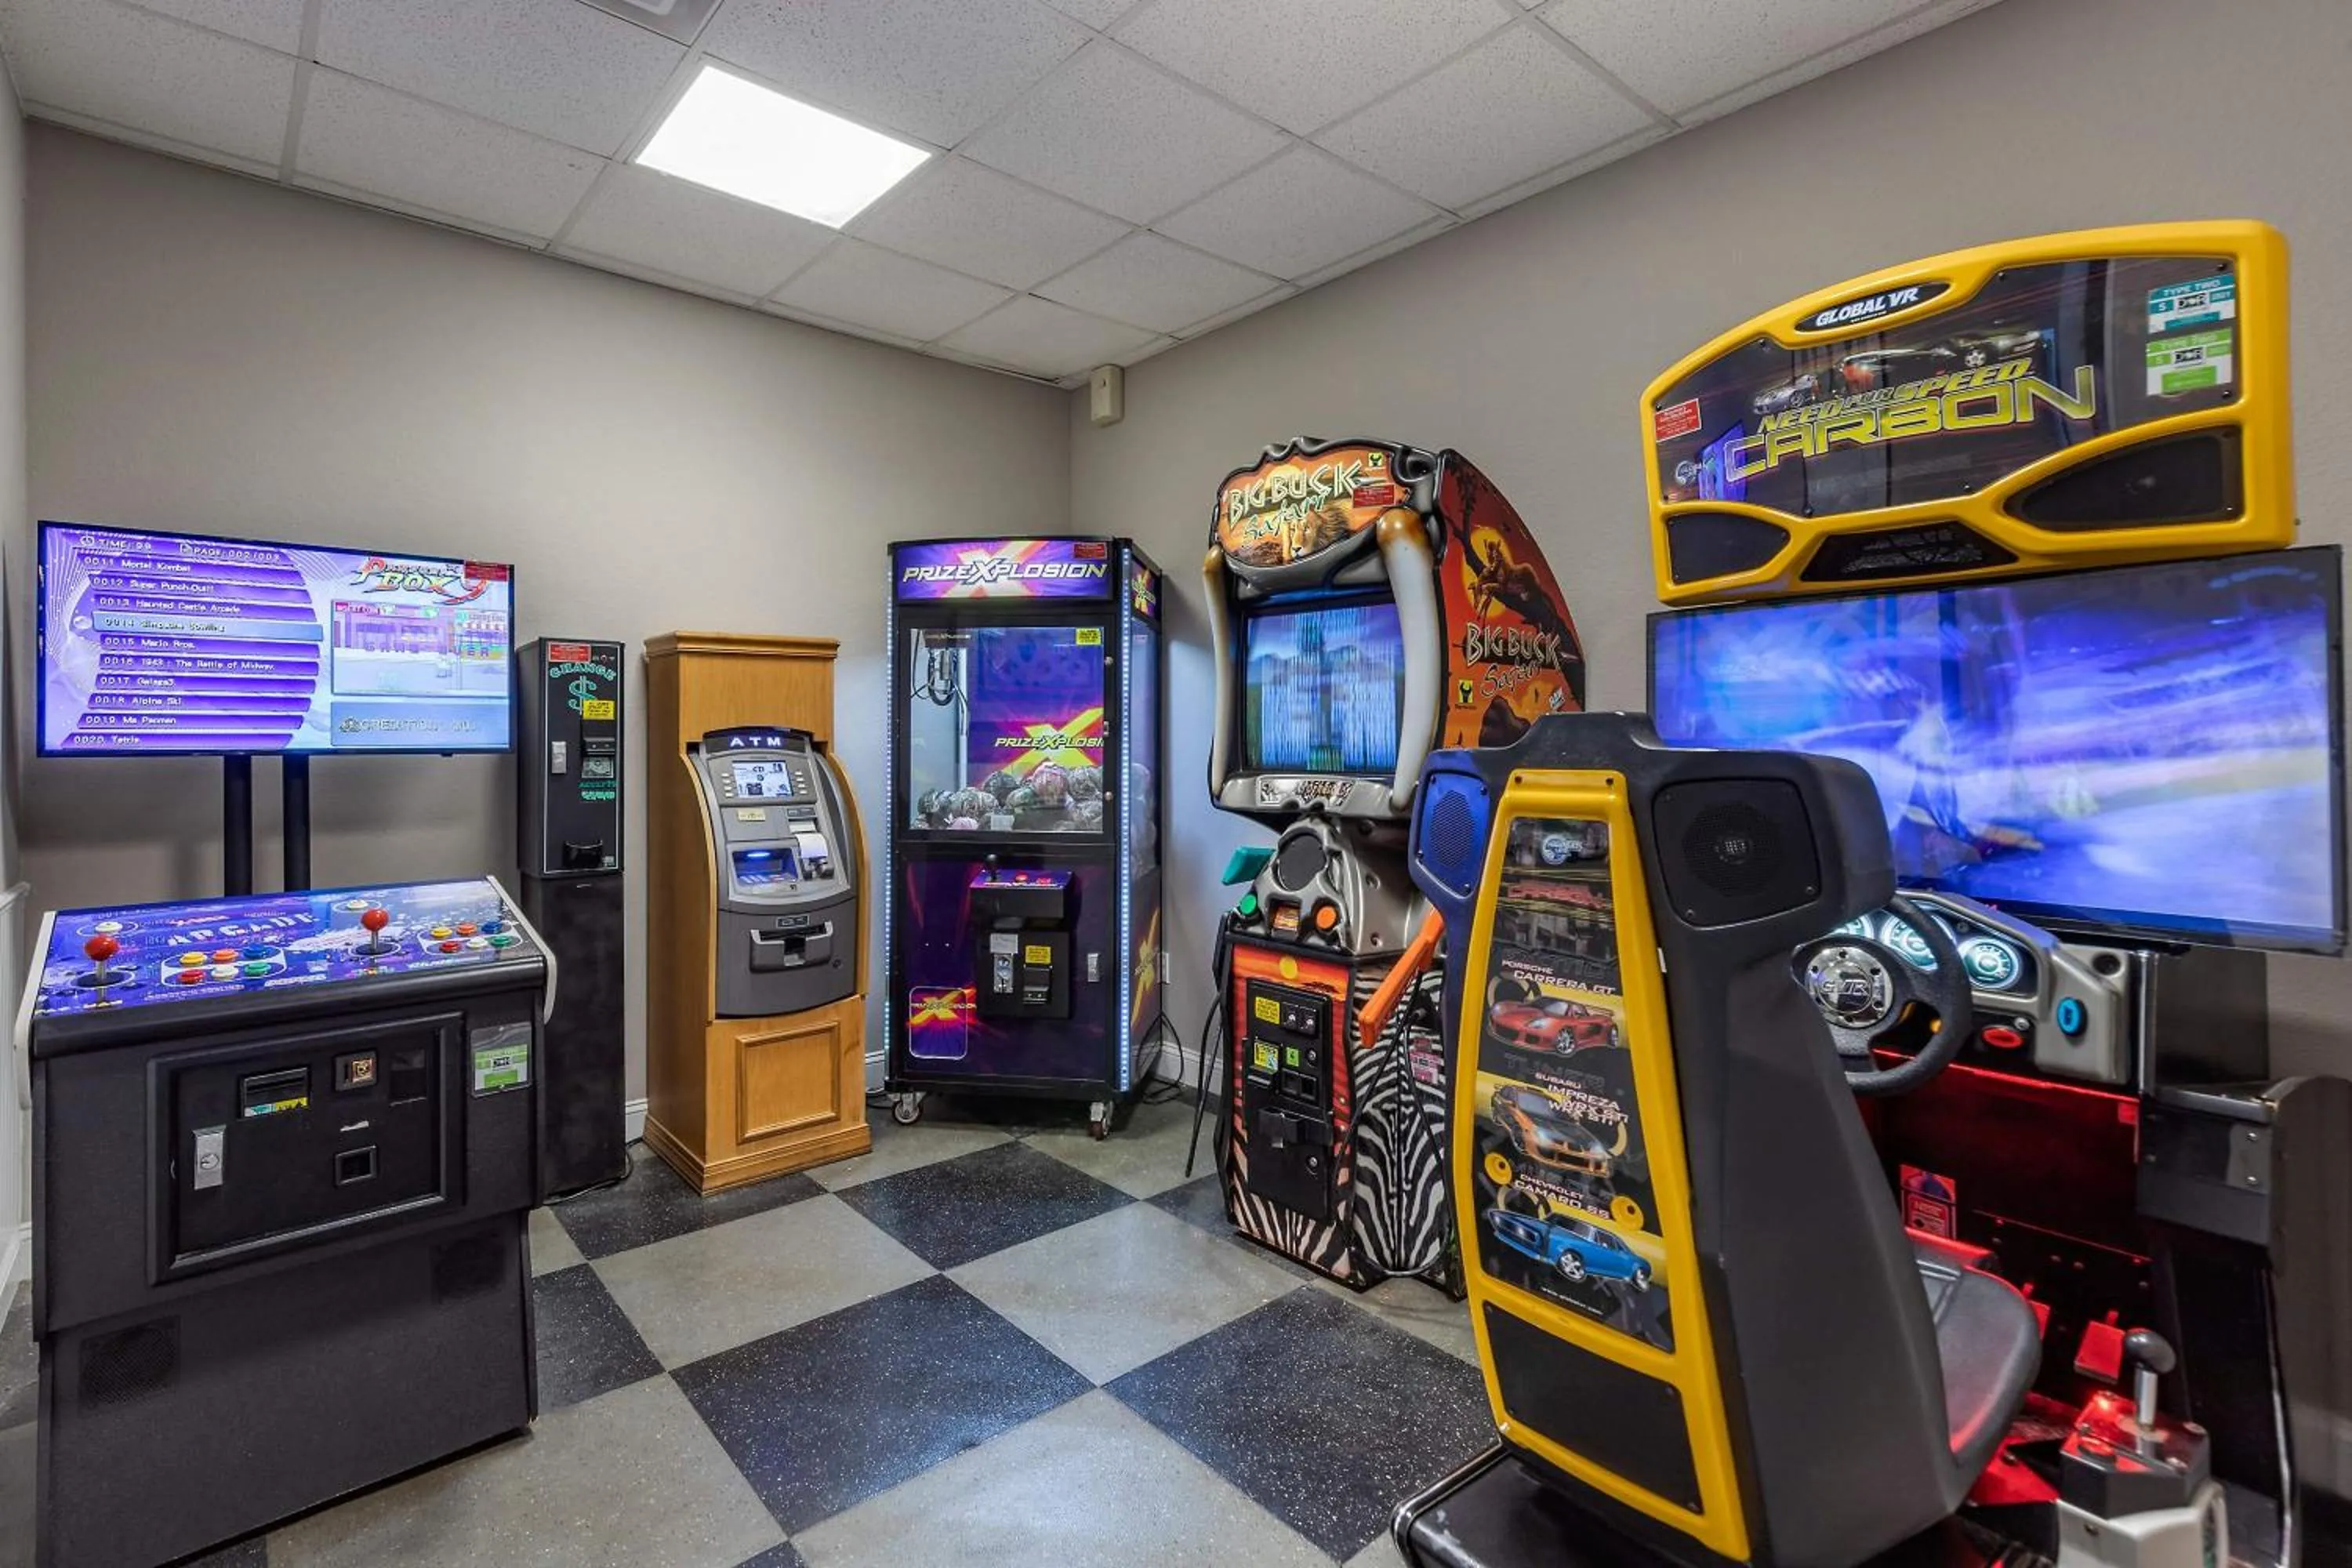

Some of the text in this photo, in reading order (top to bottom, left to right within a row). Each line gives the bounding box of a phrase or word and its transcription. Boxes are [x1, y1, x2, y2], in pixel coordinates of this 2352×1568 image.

[1815, 296, 1886, 327] GLOBAL
[1888, 287, 1919, 307] VR
[1757, 396, 1843, 434] NEED
[1893, 357, 2032, 401] SPEED
[1724, 365, 2096, 483] CARBON
[1229, 479, 1266, 530] BIG
[1269, 459, 1363, 503] BUCK
[902, 557, 1108, 586] PRIZEXPLOSION
[140, 637, 169, 648] Mario
[1466, 622, 1562, 670] BIG BUCK
[175, 659, 193, 669] The
[227, 660, 238, 670] of
[549, 662, 617, 681] CHANGE
[100, 677, 131, 687] 0017
[131, 696, 163, 706] Alpine
[730, 737, 782, 748] ATM
[1501, 958, 1555, 975] PORSCHE
[1513, 969, 1617, 996] CARRERA GT
[1534, 1072, 1582, 1090] SUBARU
[1547, 1084, 1621, 1112] IMPREZA
[1514, 1179, 1582, 1211] CAMARO
[1586, 1204, 1610, 1221] SS
[1519, 1173, 1584, 1200] CHEVROLET
